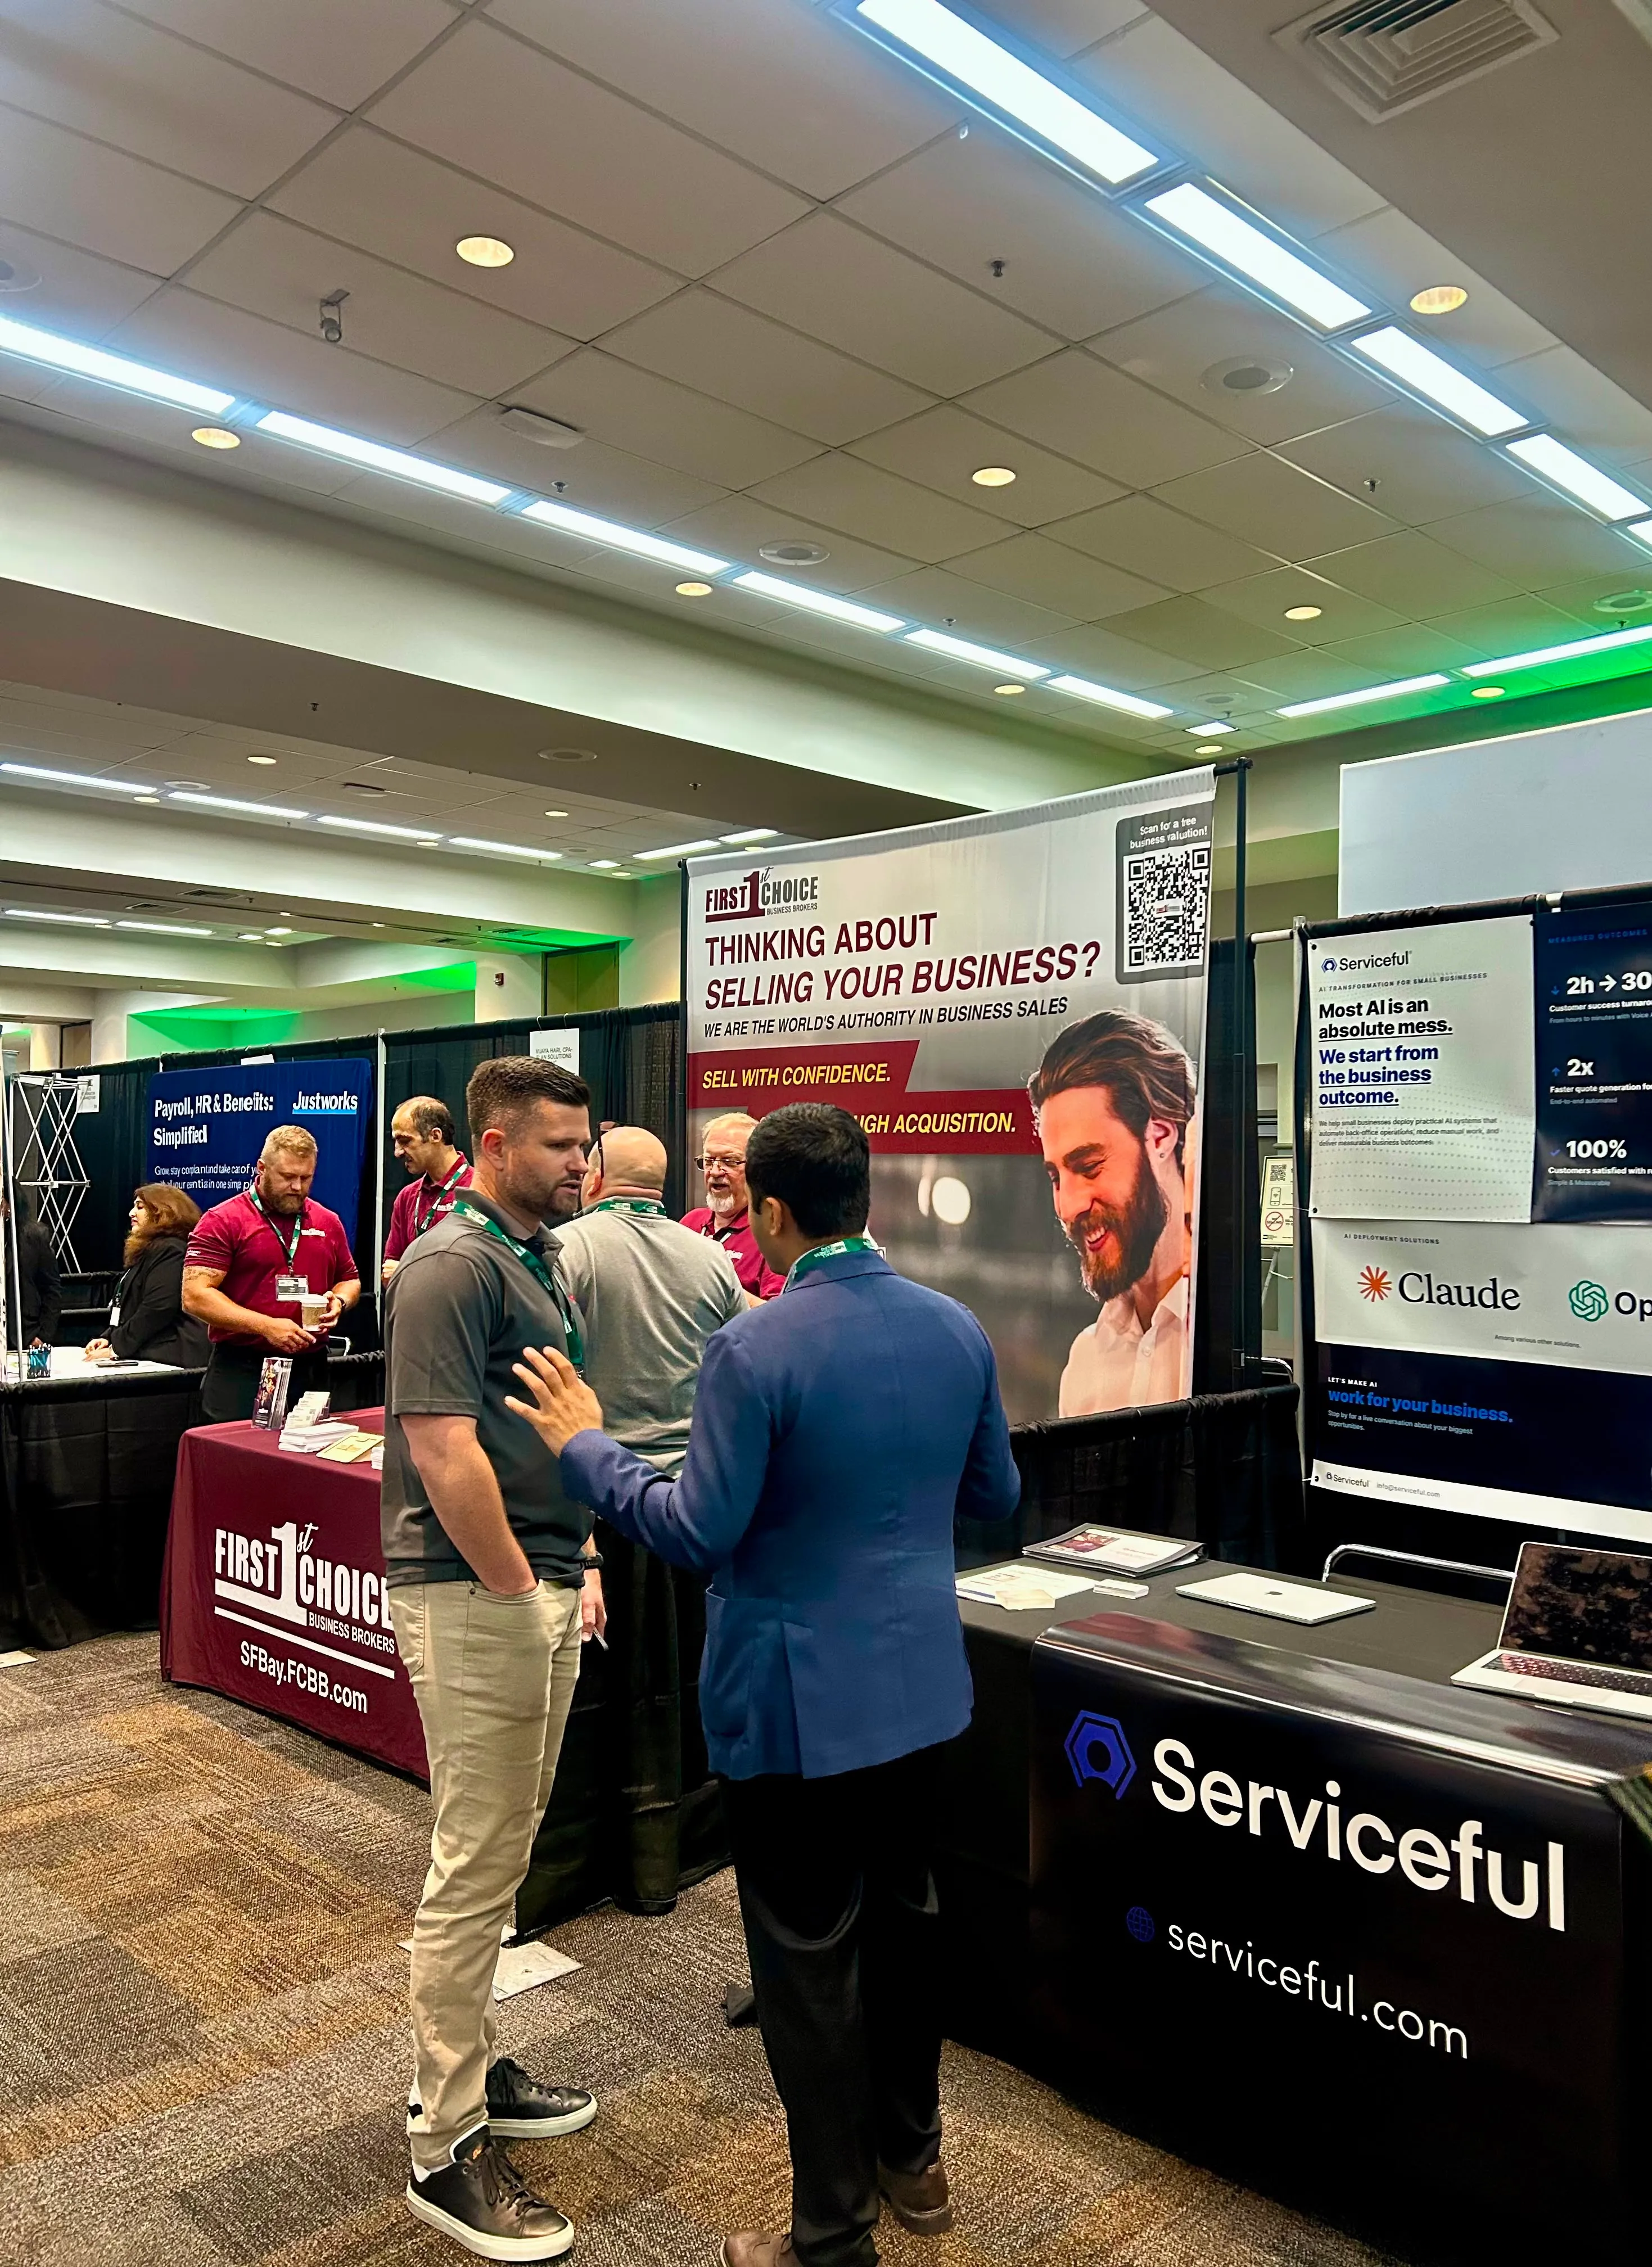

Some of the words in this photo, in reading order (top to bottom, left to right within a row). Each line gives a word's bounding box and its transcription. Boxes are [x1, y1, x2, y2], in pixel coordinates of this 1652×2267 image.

[1140, 824, 1159, 836] Scan
[1160, 821, 1171, 832] for
[1173, 820, 1179, 829] a
[1181, 816, 1197, 827] free
[1130, 835, 1166, 849] business
[705, 885, 748, 912] FIRST
[761, 876, 819, 906] CHOICE
[766, 905, 792, 916] BUSINESS
[792, 902, 818, 913] BROKERS
[705, 925, 825, 967] THINKING
[834, 912, 938, 955] ABOUT
[1339, 950, 1409, 972] Serviceful
[705, 970, 813, 1010] SELLING
[823, 964, 901, 1001] YOUR
[911, 941, 1101, 994] BUSINESS?
[1329, 981, 1394, 991] TRANSFORMATION
[1439, 972, 1488, 982] BUSINESSES
[1566, 976, 1595, 995] 2h
[704, 1023, 722, 1038] WE
[724, 1021, 748, 1036] ARE
[752, 1019, 775, 1035] THE
[778, 1015, 835, 1033] WORLD'S
[837, 1010, 915, 1029] AUTHORITY
[918, 1009, 935, 1024] IN
[937, 1002, 1014, 1022] BUSINESS
[1017, 996, 1069, 1016] SALES
[1319, 1002, 1364, 1019] Most
[1365, 999, 1385, 1016] AI
[1388, 998, 1403, 1014] is
[1406, 999, 1429, 1013] an
[1549, 1004, 1587, 1013] Customer
[1587, 1001, 1621, 1010] success
[1319, 1021, 1395, 1040] absolute
[1398, 1019, 1454, 1036] mess.
[1319, 1049, 1346, 1064] We
[1348, 1046, 1392, 1063] start
[1395, 1045, 1439, 1062] from
[702, 1070, 738, 1089] SELL
[741, 1068, 780, 1087] WITH
[782, 1062, 891, 1086] CONFIDENCE.
[1319, 1070, 1346, 1085] the
[1348, 1066, 1432, 1083] business
[1567, 1058, 1595, 1077] 2x
[1319, 1090, 1400, 1105] outcome.
[1574, 1085, 1598, 1094] quote
[1598, 1083, 1641, 1093] generation
[155, 1097, 194, 1121] Payroll,
[196, 1095, 212, 1114] HR
[214, 1094, 222, 1113] &
[223, 1091, 274, 1113] Benefits:
[292, 1091, 358, 1110] Justworks
[892, 1112, 1016, 1134] ACQUISITION.
[154, 1125, 207, 1149] Simplified
[1565, 1139, 1627, 1159] 100%
[1353, 1234, 1398, 1243] DEPLOYMENT
[1398, 1272, 1522, 1311] Claude
[1328, 1390, 1365, 1405] work
[1367, 1392, 1390, 1407] for
[1392, 1398, 1430, 1412] your
[1431, 1399, 1514, 1424] business.
[1328, 1410, 1340, 1418] Stop
[1414, 1421, 1433, 1430] about
[1333, 1474, 1370, 1488] Serviceful
[1376, 1482, 1441, 1498] info@serviceful.com
[215, 1528, 278, 1592] FIRST
[309, 1611, 350, 1639] BUSINESS
[351, 1626, 395, 1654] BROKERS
[240, 1640, 367, 1714] SFBay.FCBB.com
[1151, 1738, 1565, 1932] Serviceful
[1167, 1922, 1469, 2060] serviceful.com
